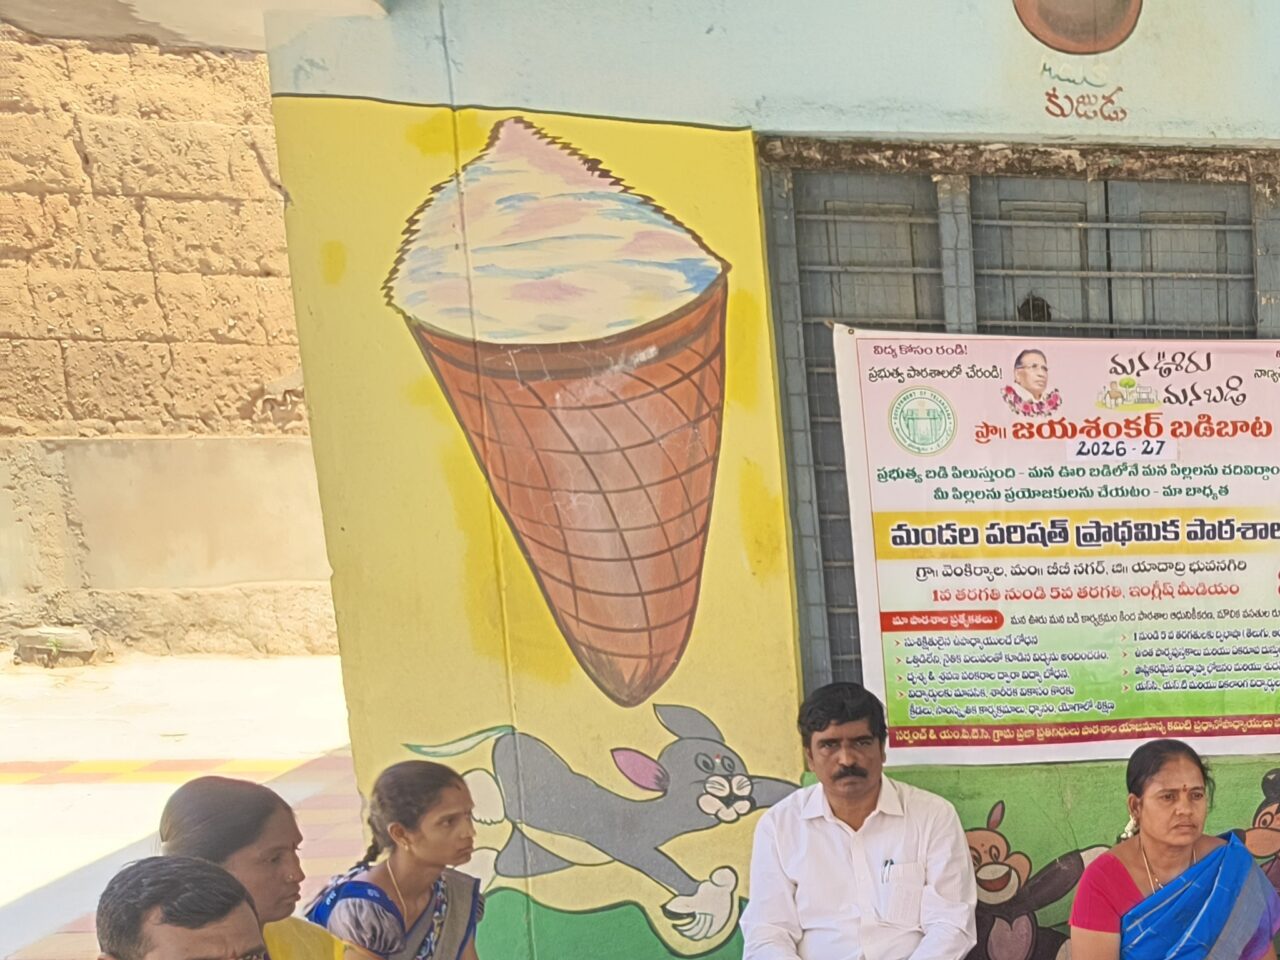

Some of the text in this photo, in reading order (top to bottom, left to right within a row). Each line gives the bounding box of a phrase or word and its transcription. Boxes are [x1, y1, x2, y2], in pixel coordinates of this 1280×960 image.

[873, 344, 967, 358] విద్య కోసం రండి!
[868, 366, 905, 383] ప్రభుత్వ
[966, 364, 1003, 380] చేరండి!
[1011, 412, 1163, 440] జయశంకర్
[1170, 413, 1273, 439] బడిబాట
[877, 466, 923, 483] ప్రభుత్వ
[925, 466, 948, 479] బడి
[951, 466, 1016, 482] పిలుస్తుంది
[1028, 466, 1054, 478] మన
[1058, 466, 1086, 478] ఊరి
[1089, 462, 1139, 478] బడిలోనే
[1142, 464, 1167, 477] మన
[1170, 463, 1218, 480] పిల్లలను
[933, 485, 1229, 503] మీ పిల్లలను ప్రయోజకులను చేయటం మా బాధ్యత
[890, 523, 979, 546] మండల
[985, 519, 1069, 548] పరిషత్
[1189, 559, 1247, 575] భువనగిరి
[955, 588, 1001, 602] తరగతి
[1004, 586, 1046, 601] నుండి
[1178, 581, 1240, 597] మీడియం
[1010, 614, 1026, 625] మన
[1029, 614, 1047, 625] ఊరు
[1049, 614, 1065, 624] మన
